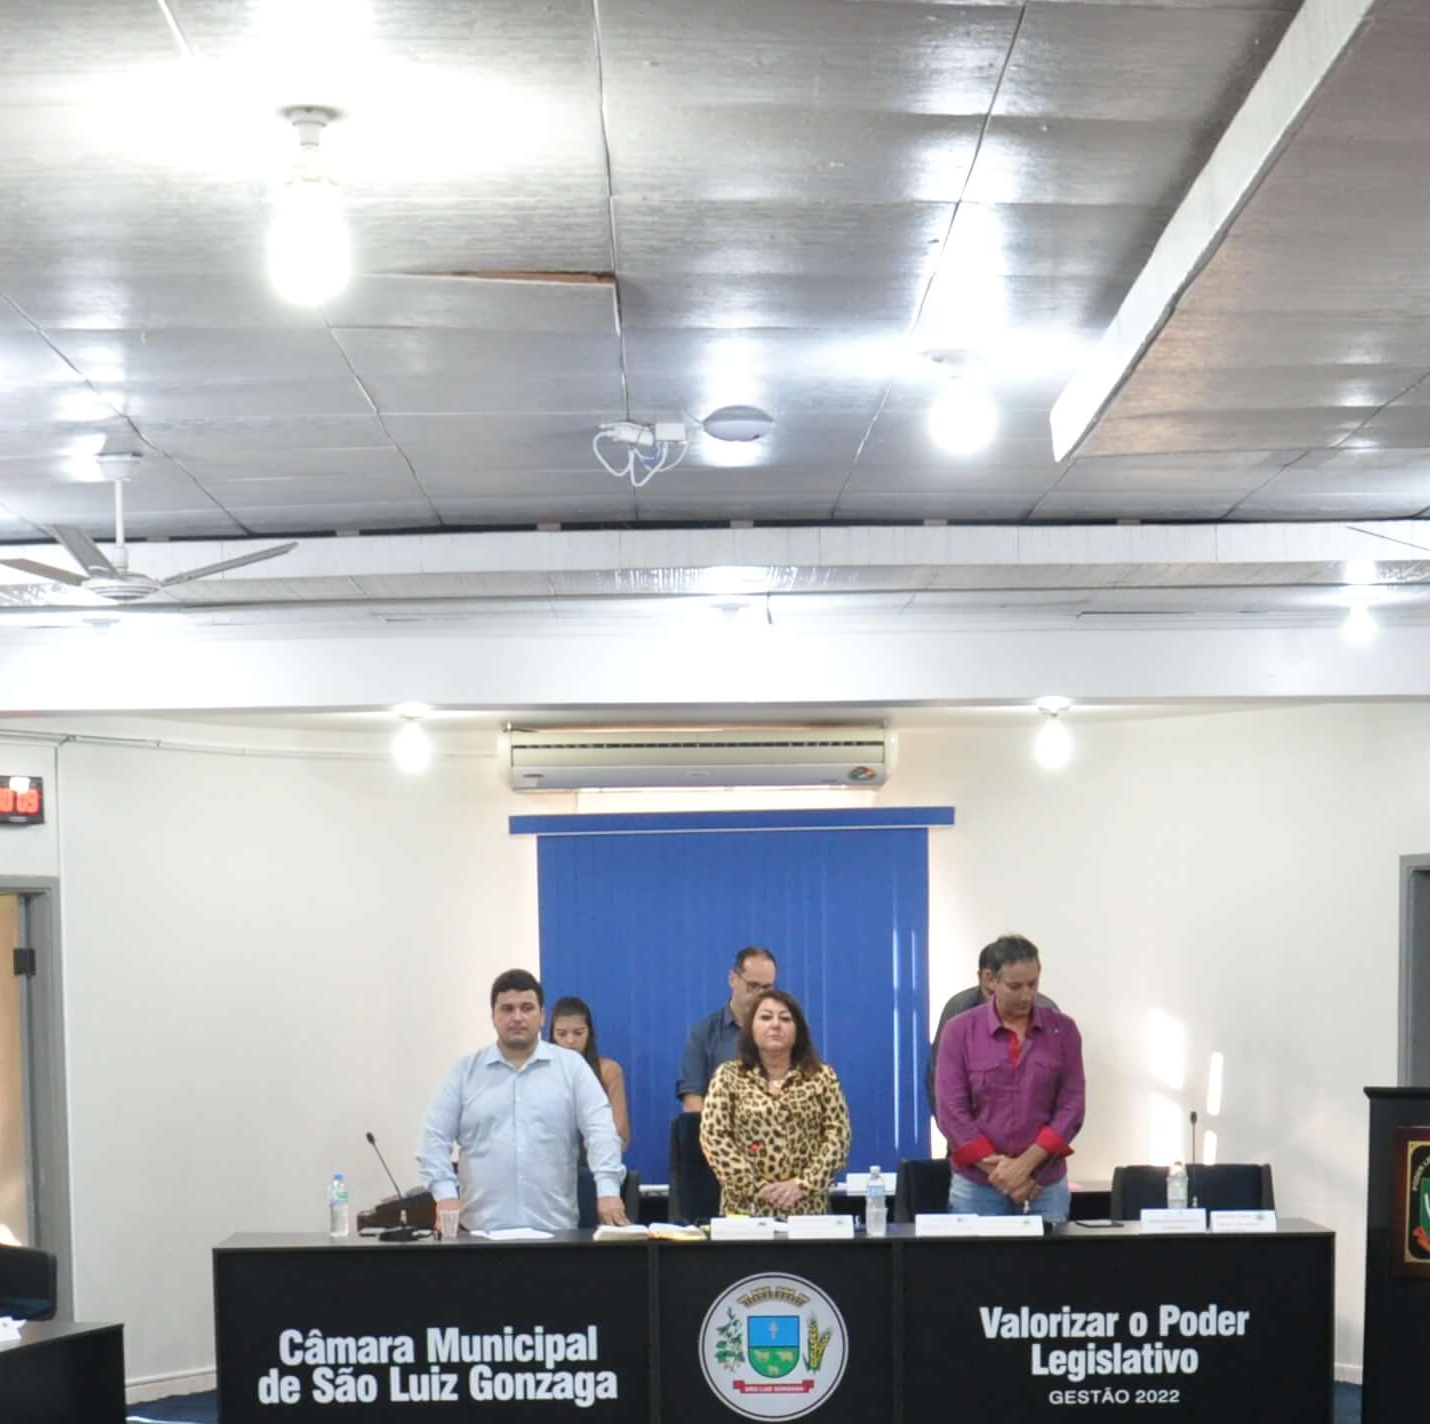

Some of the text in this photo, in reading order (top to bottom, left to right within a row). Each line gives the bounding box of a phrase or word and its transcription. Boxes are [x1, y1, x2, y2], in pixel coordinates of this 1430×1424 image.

[979, 1303, 1251, 1339] Valorizar o Poder
[278, 1324, 598, 1370] Câmara Municipal
[1031, 1341, 1199, 1383] Legislativo
[258, 1364, 619, 1408] de São Luiz Gonzaga
[1048, 1386, 1180, 1405] GESTÃO 2022
